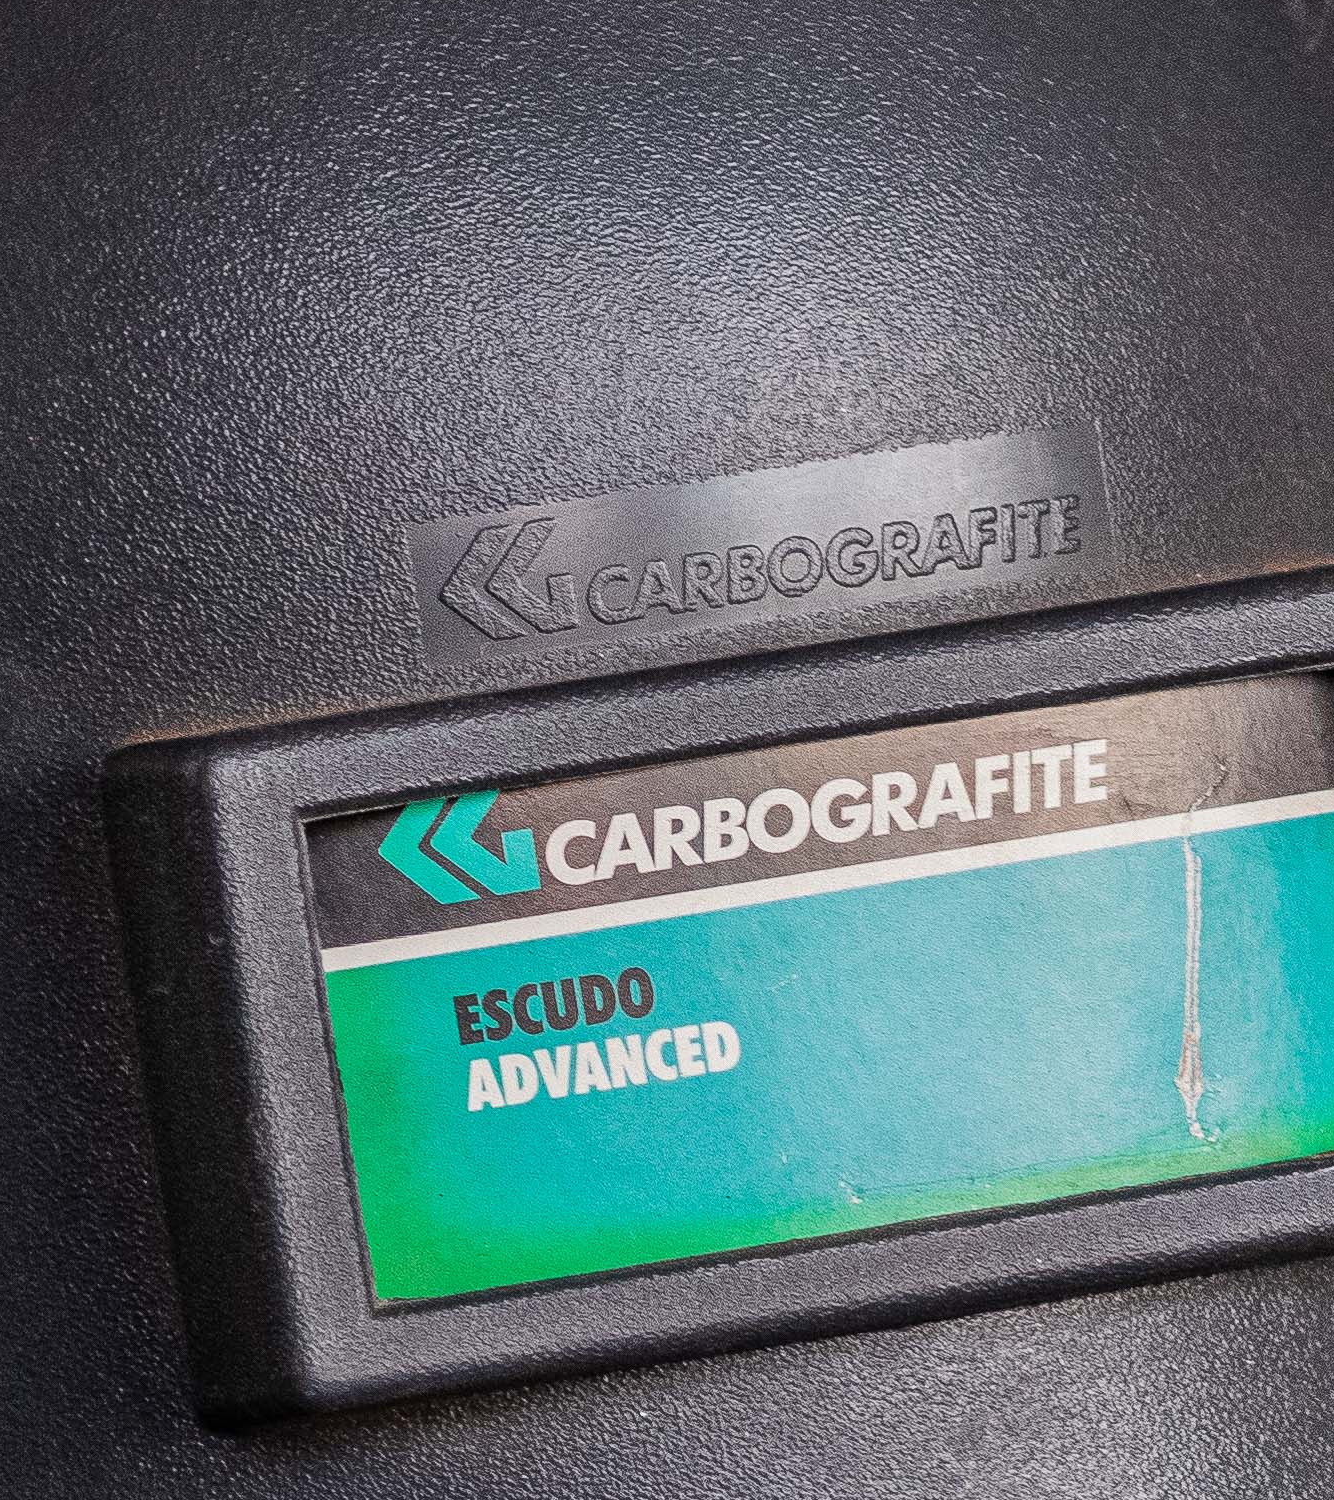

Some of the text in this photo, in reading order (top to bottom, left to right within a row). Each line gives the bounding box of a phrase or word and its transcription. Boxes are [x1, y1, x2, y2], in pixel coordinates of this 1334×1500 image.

[585, 497, 1083, 626] CARBOGRAFITE
[544, 738, 1110, 887] CARBOGRAFITE
[452, 966, 657, 1046] ESCUDO
[466, 1020, 741, 1112] ADVANCED
